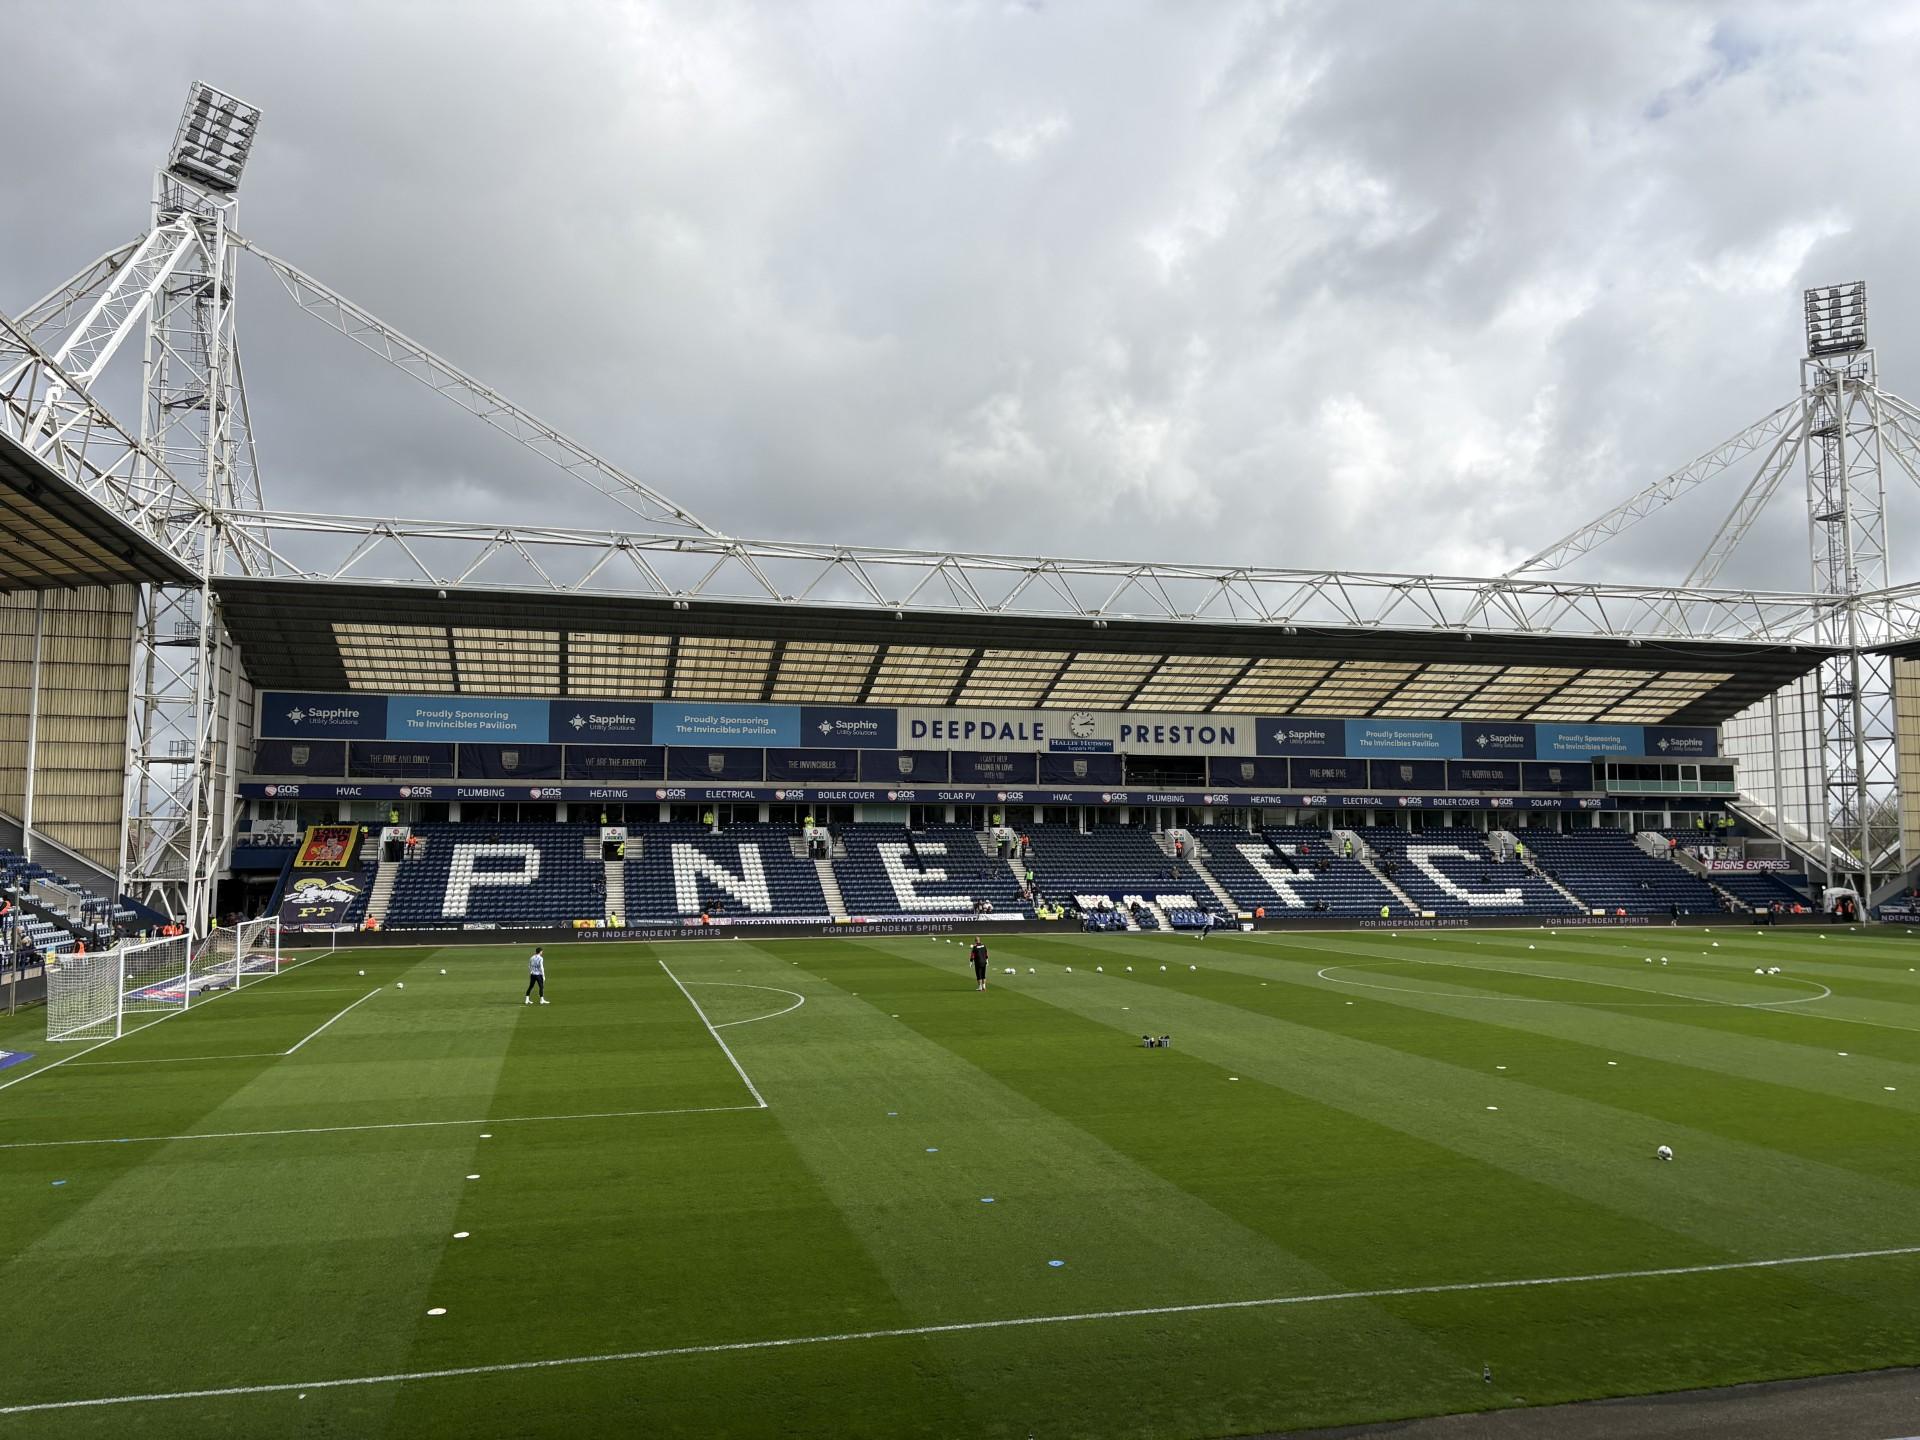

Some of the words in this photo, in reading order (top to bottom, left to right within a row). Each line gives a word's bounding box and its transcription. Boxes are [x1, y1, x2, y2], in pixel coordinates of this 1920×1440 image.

[308, 707, 360, 720] Sapphire
[416, 709, 453, 720] Proudly
[455, 710, 509, 721] Sponsoring
[309, 718, 327, 726] Utility
[407, 719, 424, 728] The
[426, 719, 477, 729] Invincibles
[479, 720, 517, 730] Pavilion
[589, 714, 636, 726] Sapphire
[684, 715, 719, 725] Proudly
[720, 716, 769, 726] Sponsoring
[590, 724, 606, 732] Utility
[676, 725, 691, 733] The
[693, 725, 741, 734] Invincibles
[742, 726, 777, 734] Pavilion
[836, 720, 878, 730] Sapphire
[911, 720, 1043, 740] DEEPDALE
[1120, 725, 1235, 744] PRESTON
[1288, 730, 1325, 740] Sapphire
[1366, 730, 1393, 739] Proudly
[1394, 731, 1433, 740] Sponsoring
[1489, 734, 1524, 744] Sapphire
[1558, 734, 1584, 743] Proudly
[1584, 735, 1621, 744] Sponsoring
[1360, 739, 1372, 747] The
[1374, 739, 1411, 747] Invincibles
[1412, 740, 1440, 748] Pavilion
[1565, 743, 1600, 751] Invincibles
[1670, 738, 1703, 748] Sapphire
[800, 760, 837, 769] INVINCIBLES
[277, 785, 299, 793] GOS
[336, 787, 362, 796] HVAC
[411, 786, 432, 794] GOS
[457, 788, 505, 797] PLUMBING
[542, 788, 561, 796] GOS
[590, 789, 628, 798] HEATING
[667, 788, 686, 796] GOS
[785, 789, 804, 797] GOS
[706, 790, 755, 799] ELECTRICAL
[818, 791, 847, 799] BOILER
[848, 791, 875, 800] COVER
[897, 790, 915, 798] GOS
[938, 792, 963, 800] SOLAR
[965, 792, 976, 800] PV
[1053, 793, 1073, 801] HVAC
[1147, 795, 1184, 803] PLUMBING
[1250, 796, 1281, 804] HEATING
[1343, 797, 1383, 805] ELECTRICAL
[1433, 798, 1457, 806] BOILER
[1458, 798, 1480, 806] COVER
[1499, 798, 1513, 806] GOS
[1531, 799, 1551, 807] SOLAR
[1553, 799, 1562, 807] PV
[252, 833, 295, 845] PNE
[1713, 860, 1744, 870] SIGNS
[1746, 860, 1790, 870] EXPRESS
[1359, 920, 1375, 928] FOR
[1377, 920, 1435, 928] INDEPENDENT
[1563, 917, 1618, 925] INDEPENDENT
[577, 930, 599, 938] FOR
[602, 929, 677, 938] INDEPENDENT
[680, 928, 721, 937] SPIRITS
[822, 925, 845, 933] FOR
[846, 924, 913, 933] INDEPENDENT
[916, 924, 953, 932] SPIRITS
